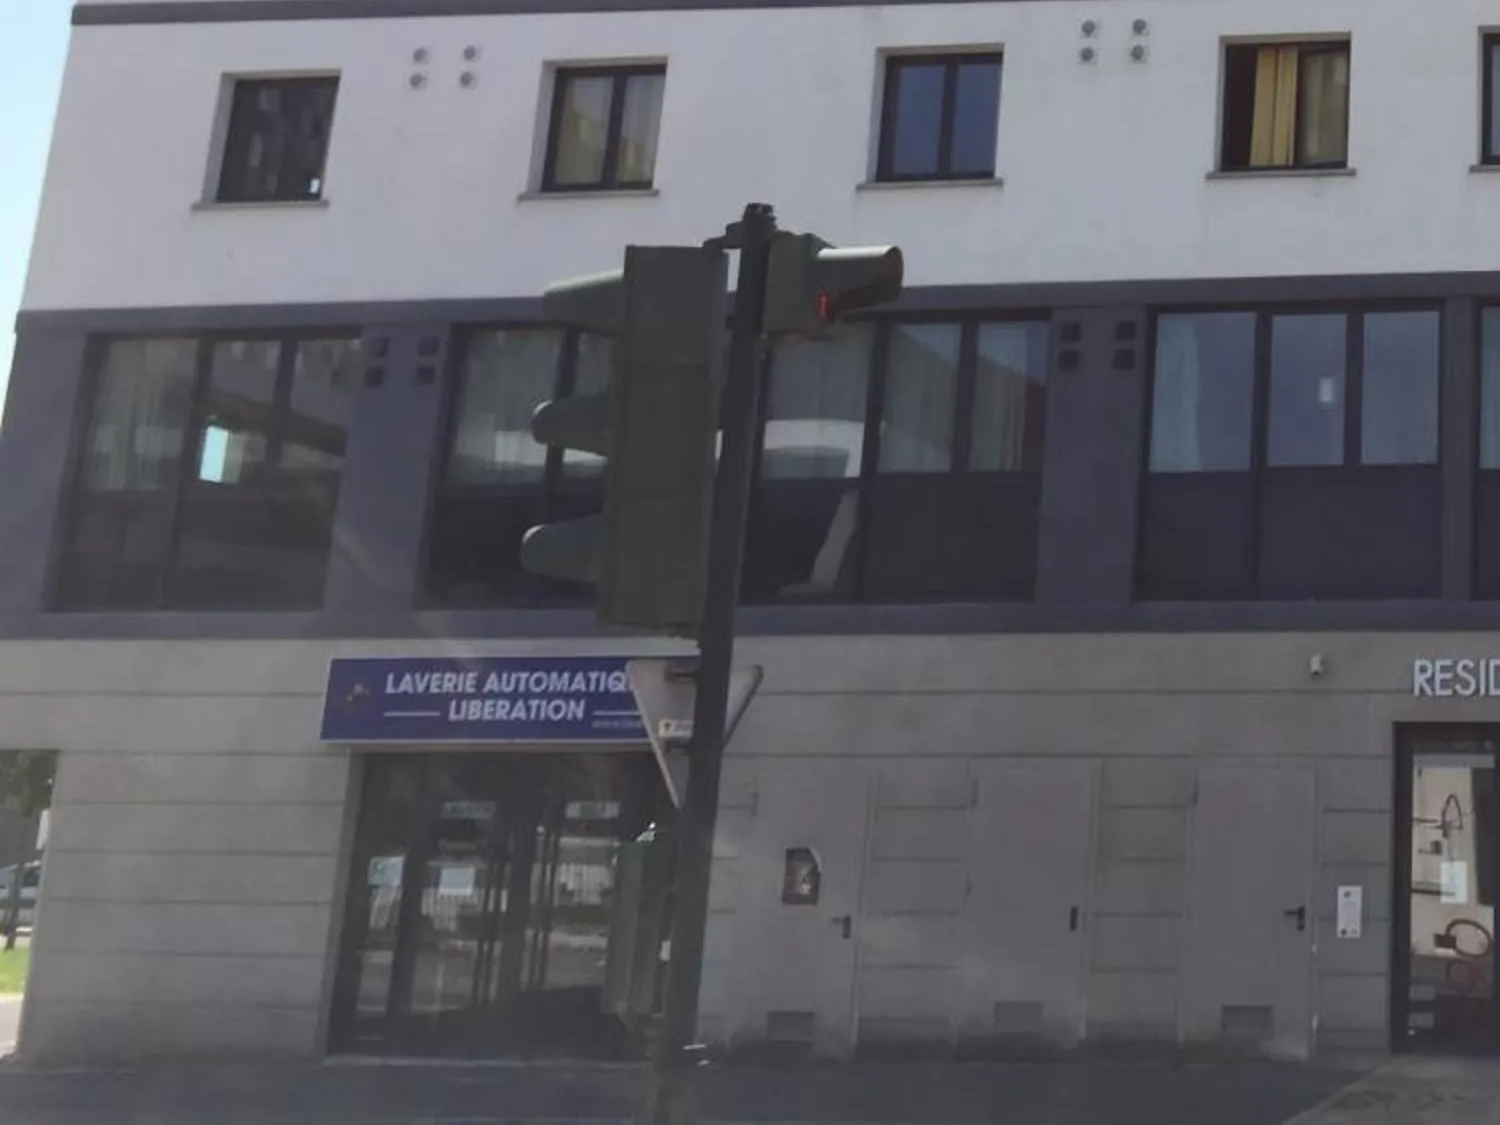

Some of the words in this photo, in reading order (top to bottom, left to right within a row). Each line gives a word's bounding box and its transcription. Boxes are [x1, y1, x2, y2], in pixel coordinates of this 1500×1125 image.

[385, 671, 476, 695] LAVERIE
[482, 670, 636, 694] AUTOMATIQ
[448, 696, 585, 722] LIBERATION
